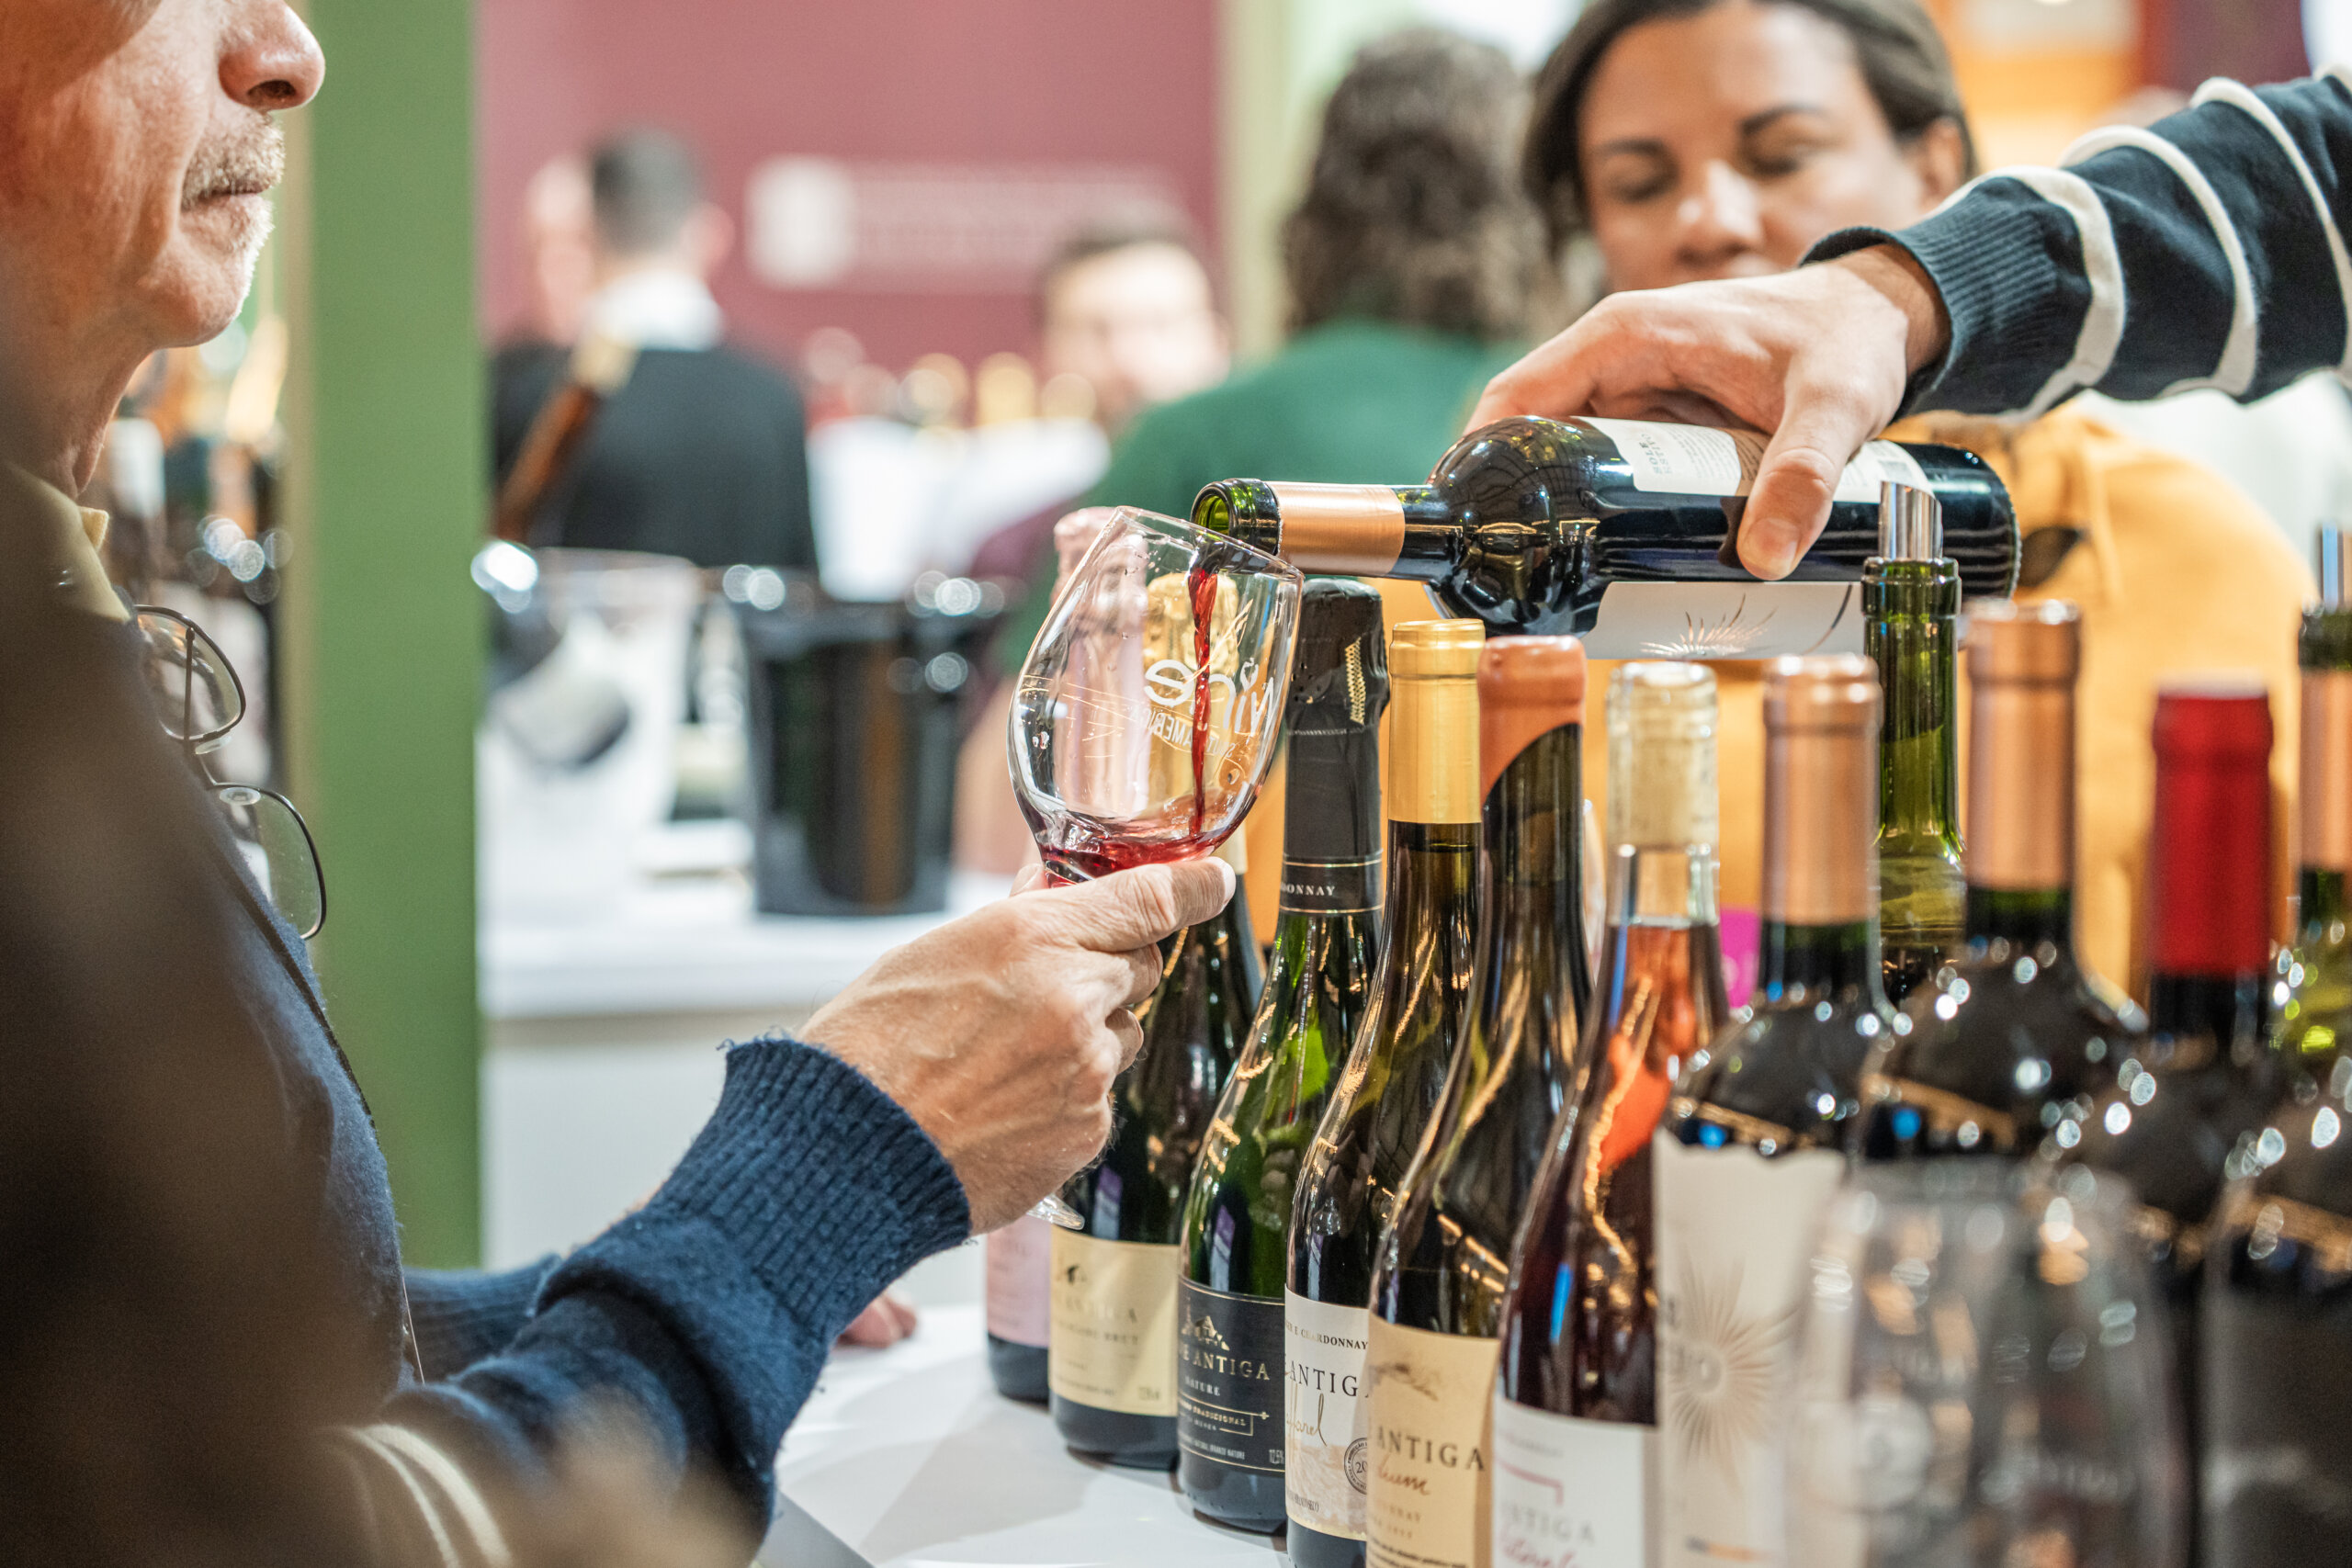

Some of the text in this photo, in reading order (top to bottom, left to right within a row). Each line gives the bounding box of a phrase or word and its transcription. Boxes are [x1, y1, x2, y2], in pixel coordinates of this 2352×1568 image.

[1193, 1351, 1271, 1381] ANTIGA
[1289, 1359, 1369, 1398] ANTIG
[1377, 1425, 1486, 1472] ANTIGA
